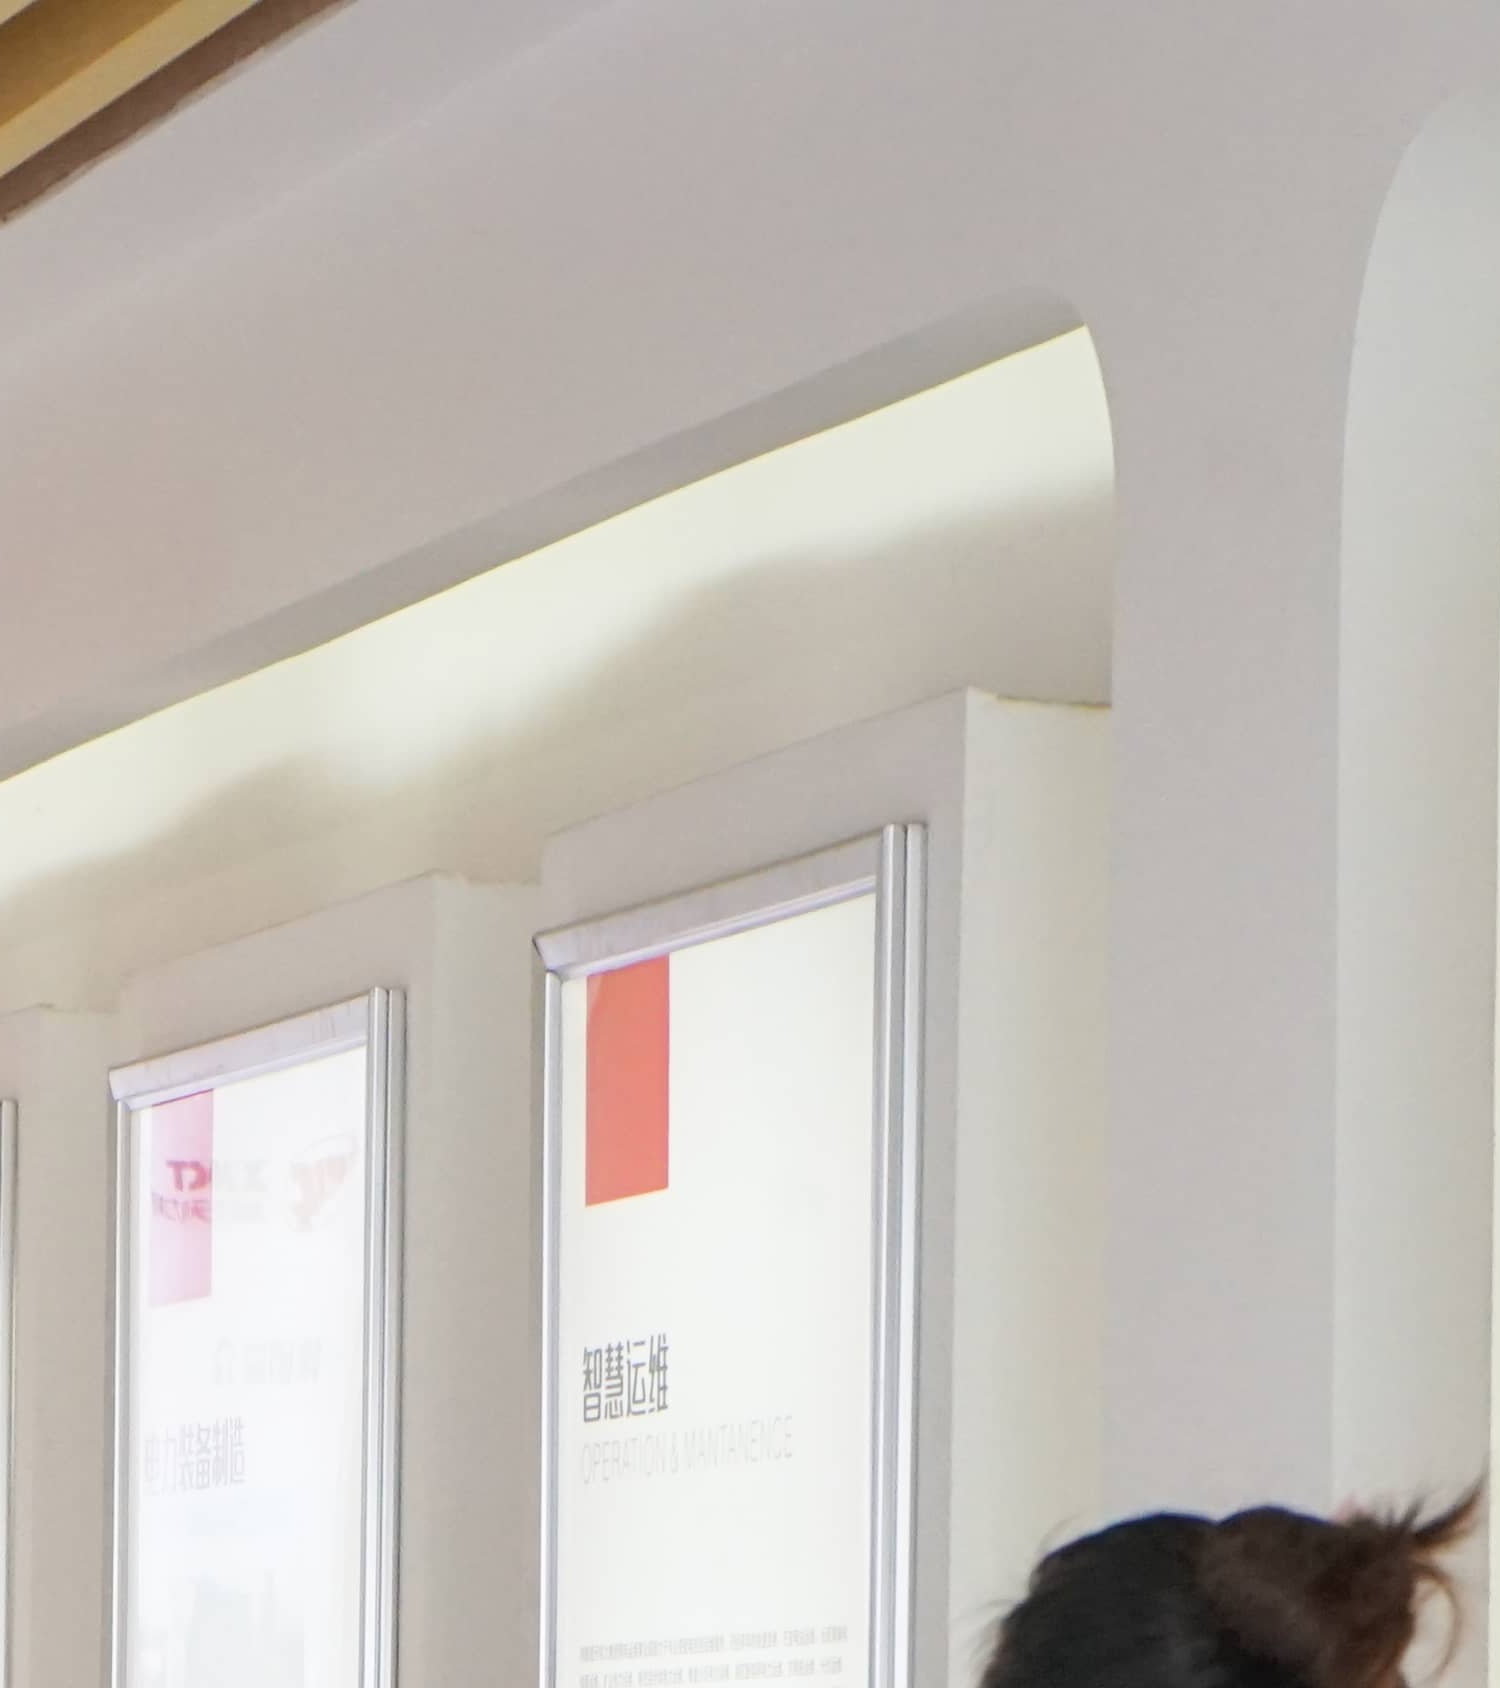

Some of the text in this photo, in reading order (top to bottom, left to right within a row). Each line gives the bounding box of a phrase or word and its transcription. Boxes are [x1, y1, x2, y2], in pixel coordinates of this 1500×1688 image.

[582, 1333, 671, 1424] 智慧运维
[143, 1415, 247, 1496] 电力装备制造
